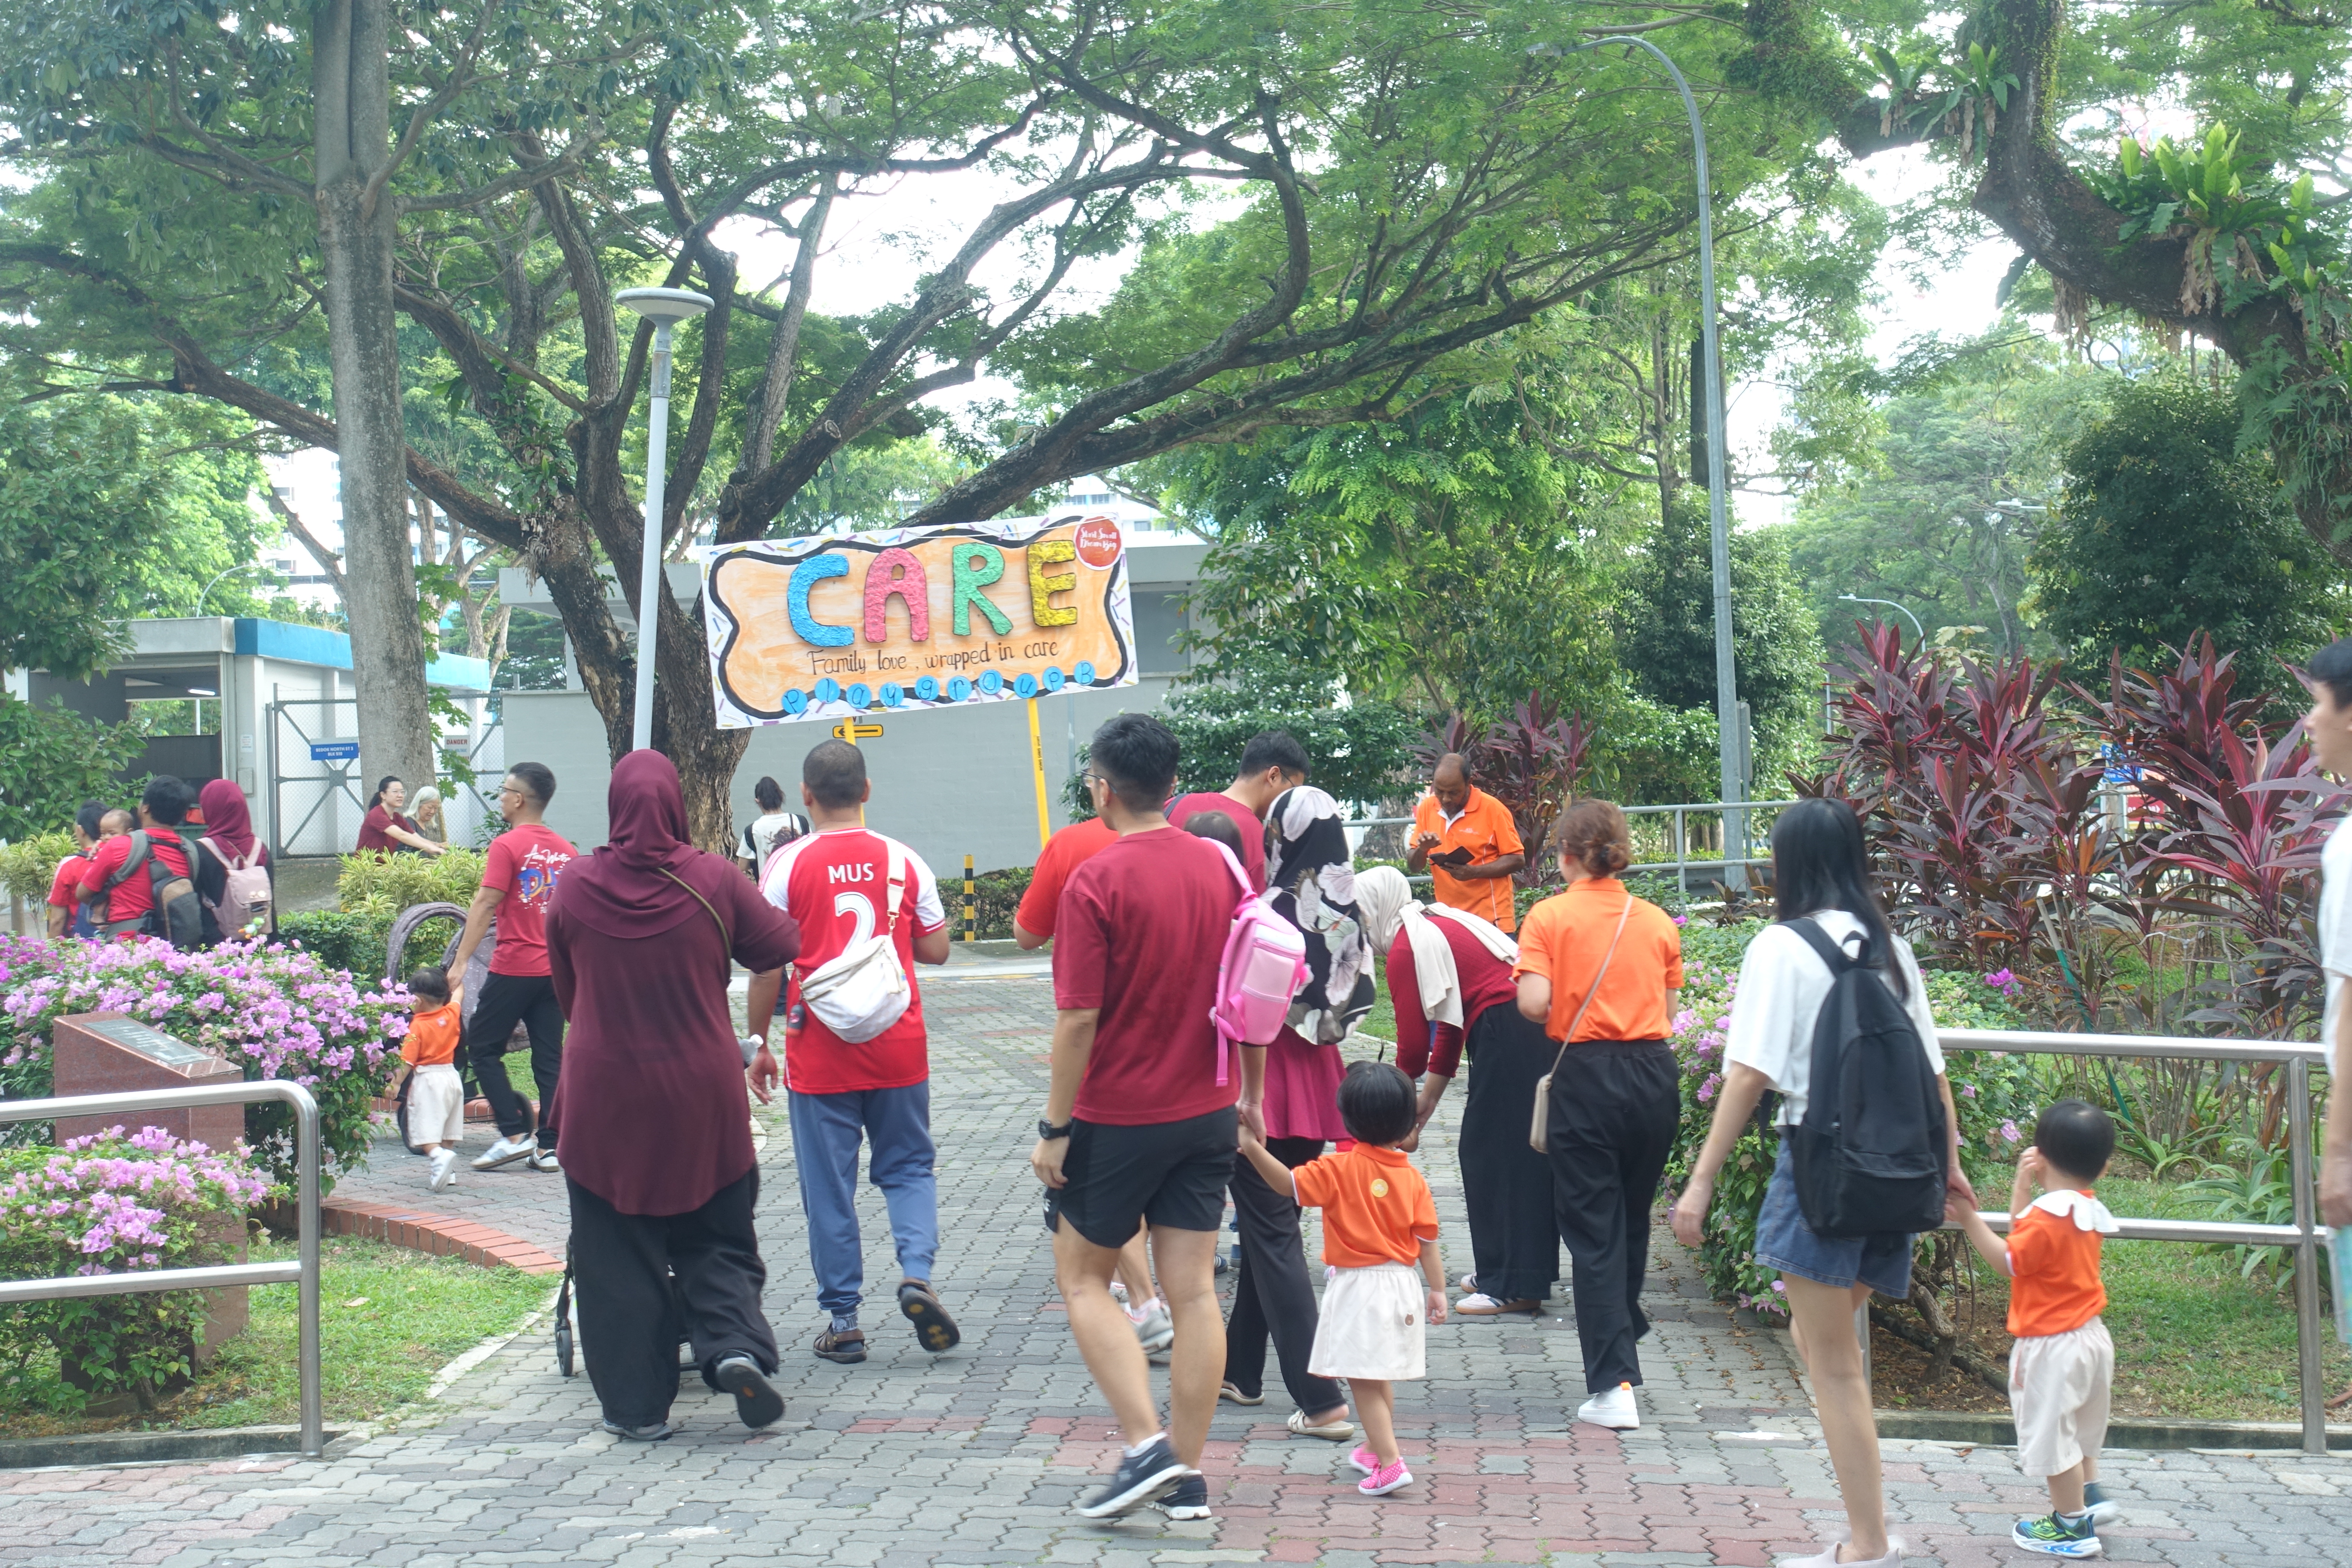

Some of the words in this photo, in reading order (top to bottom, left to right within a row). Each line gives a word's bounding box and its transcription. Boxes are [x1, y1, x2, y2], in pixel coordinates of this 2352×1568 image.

[1102, 540, 1117, 551] Big
[787, 539, 1078, 647] CARE
[806, 649, 866, 675] Family
[925, 641, 991, 671] wrapped
[998, 642, 1015, 661] in
[1024, 641, 1060, 658] care
[827, 863, 874, 884] MUS
